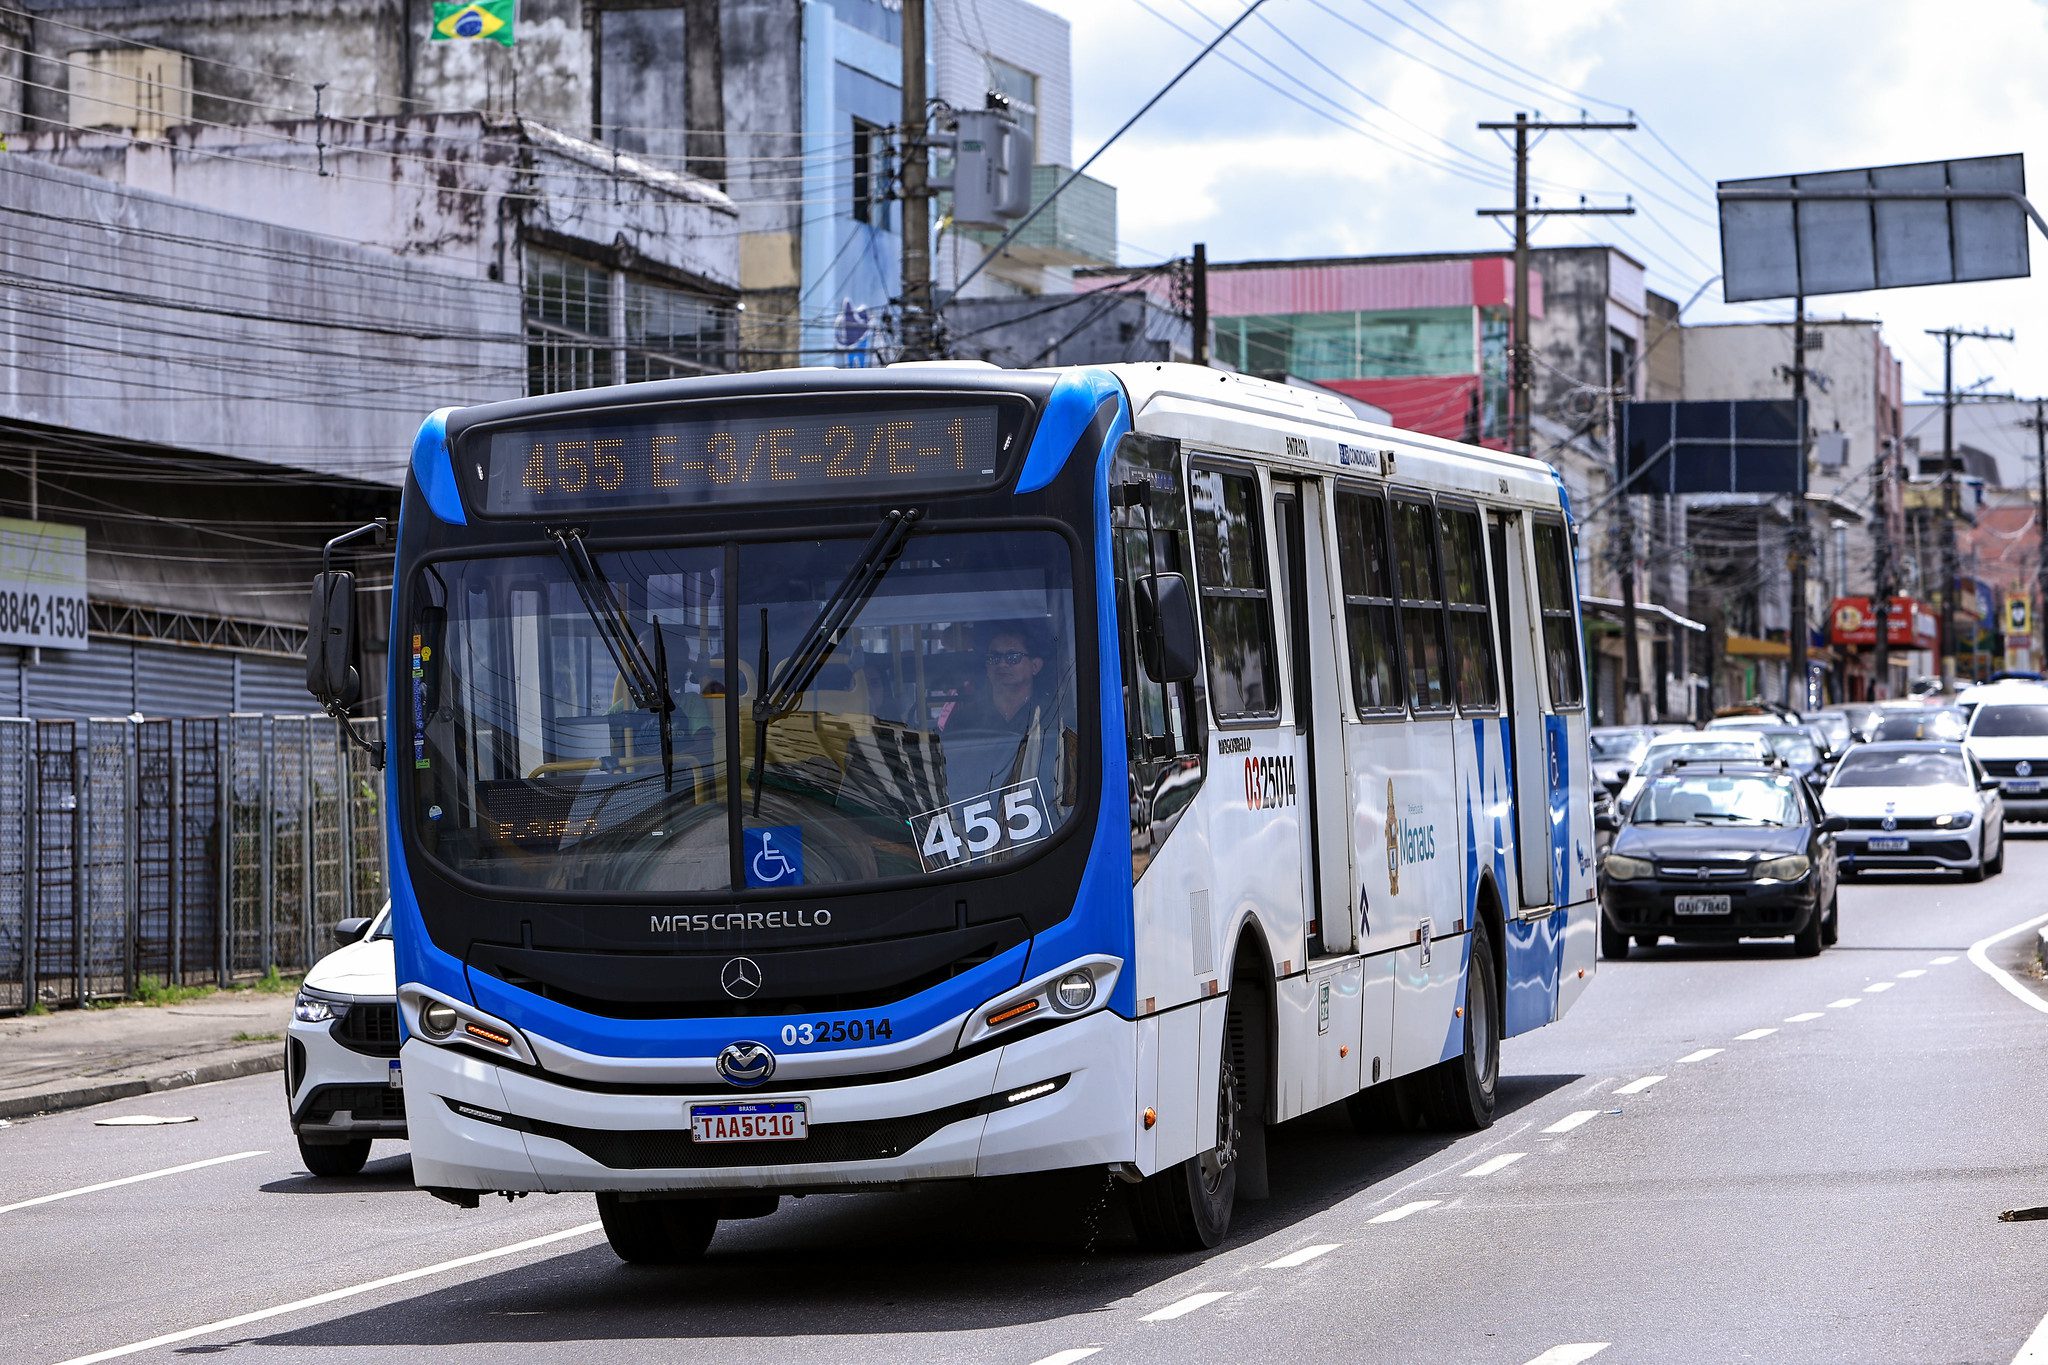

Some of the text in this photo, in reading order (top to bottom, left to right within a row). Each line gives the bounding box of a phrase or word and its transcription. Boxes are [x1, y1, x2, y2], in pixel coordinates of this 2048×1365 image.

[520, 417, 965, 495] 455 E-3/E-2/E-1
[0, 590, 86, 639] 8842-1530
[1245, 754, 1296, 811] 0325014
[922, 788, 1042, 861] 455
[1399, 818, 1435, 866] Manaus
[650, 909, 832, 932] MASCARELLO
[781, 1018, 893, 1046] 0325014
[701, 1114, 794, 1139] TAA5C10
